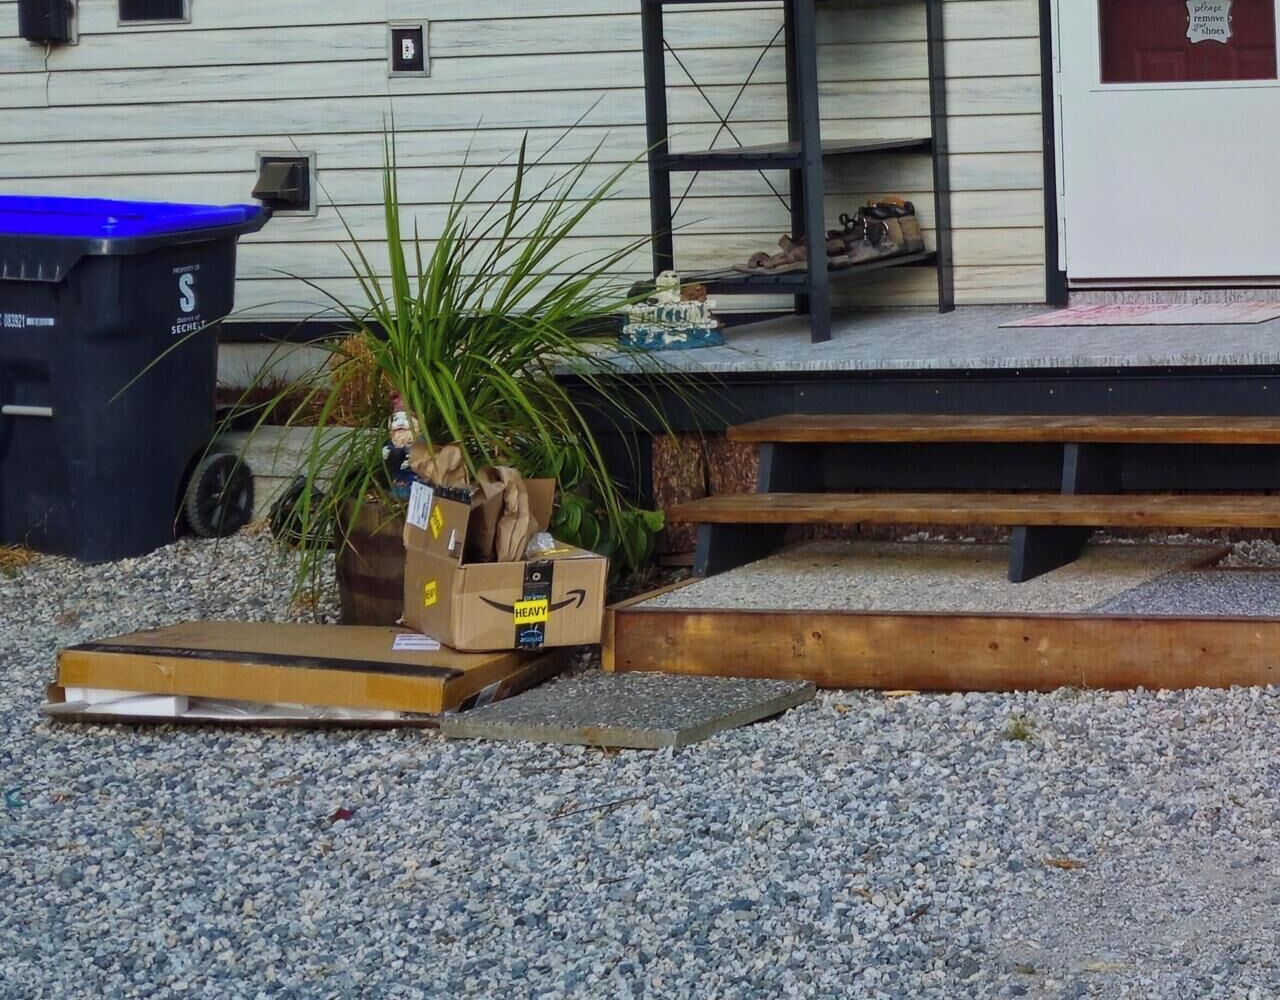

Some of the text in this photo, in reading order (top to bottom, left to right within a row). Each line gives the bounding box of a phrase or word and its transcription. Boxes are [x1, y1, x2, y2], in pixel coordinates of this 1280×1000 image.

[1201, 26, 1225, 35] shoes
[178, 273, 195, 313] S
[515, 606, 546, 618] HEAVY
